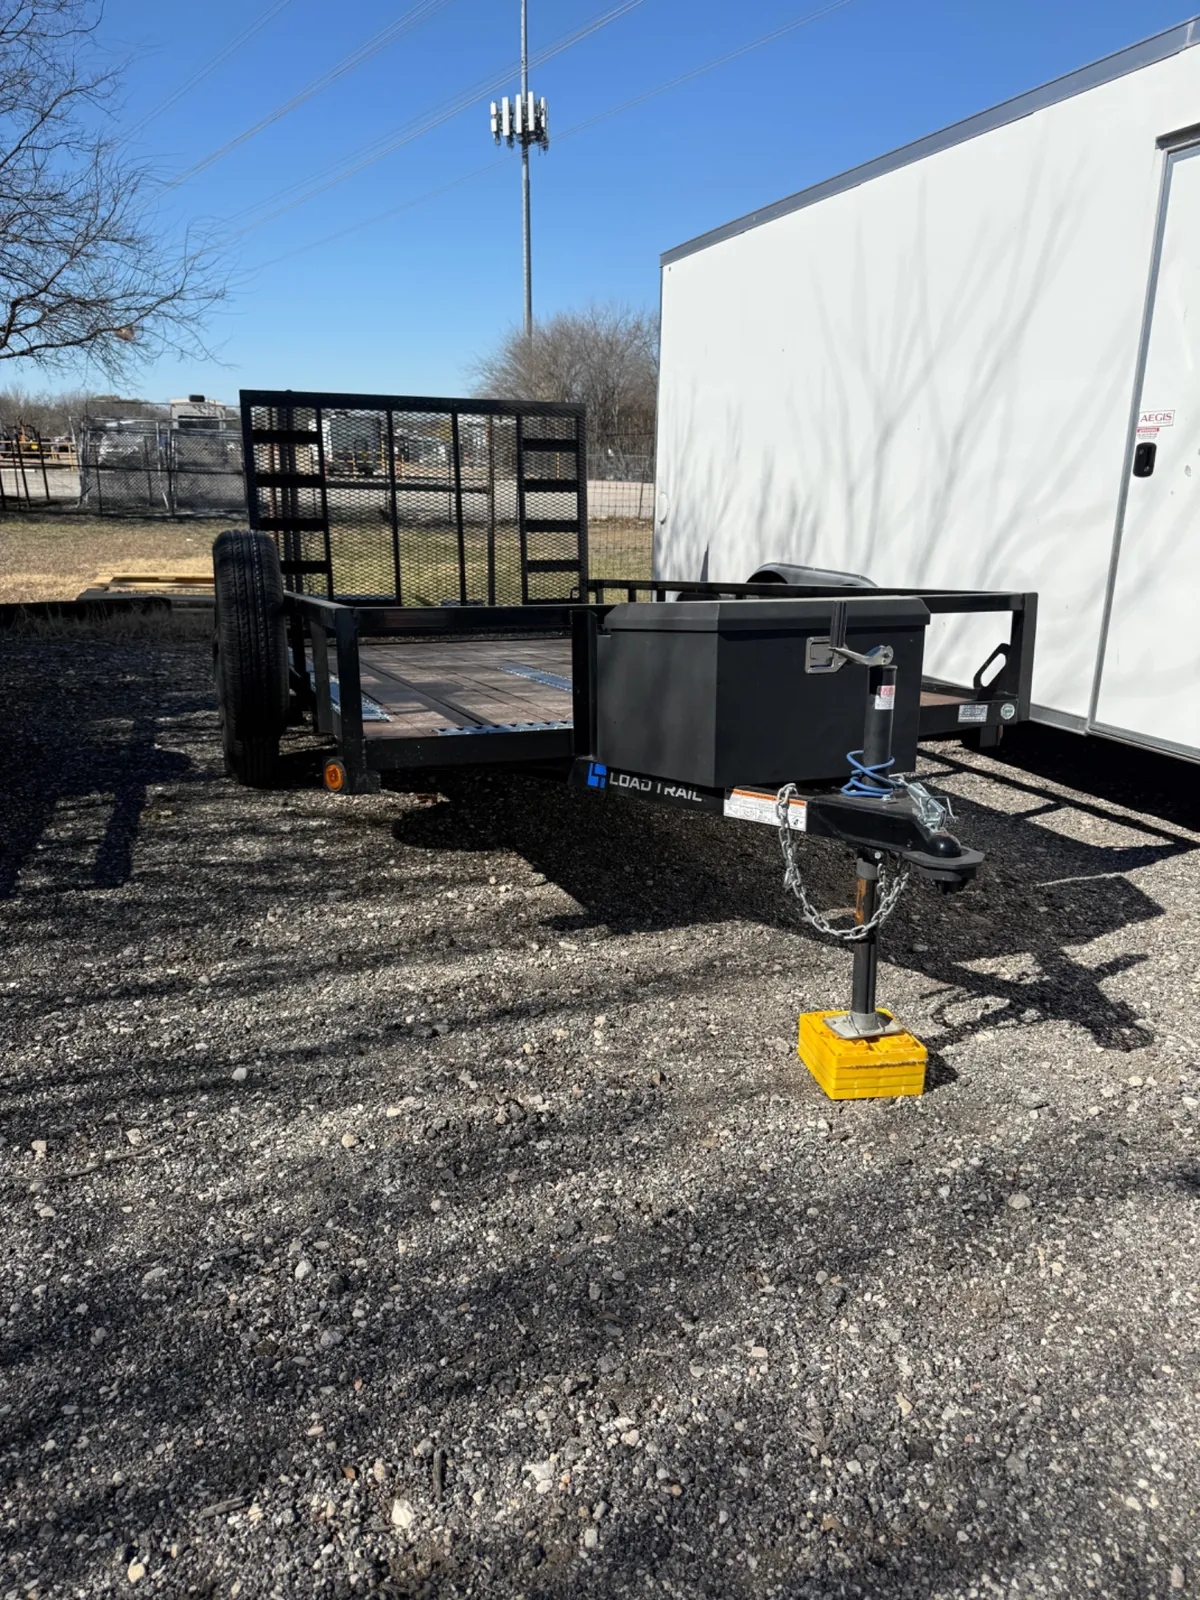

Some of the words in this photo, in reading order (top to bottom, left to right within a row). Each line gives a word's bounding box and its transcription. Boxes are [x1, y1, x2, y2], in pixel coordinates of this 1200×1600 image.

[1140, 412, 1172, 422] AEGIS
[609, 771, 652, 792] LOAD
[654, 780, 703, 803] TRAIL
